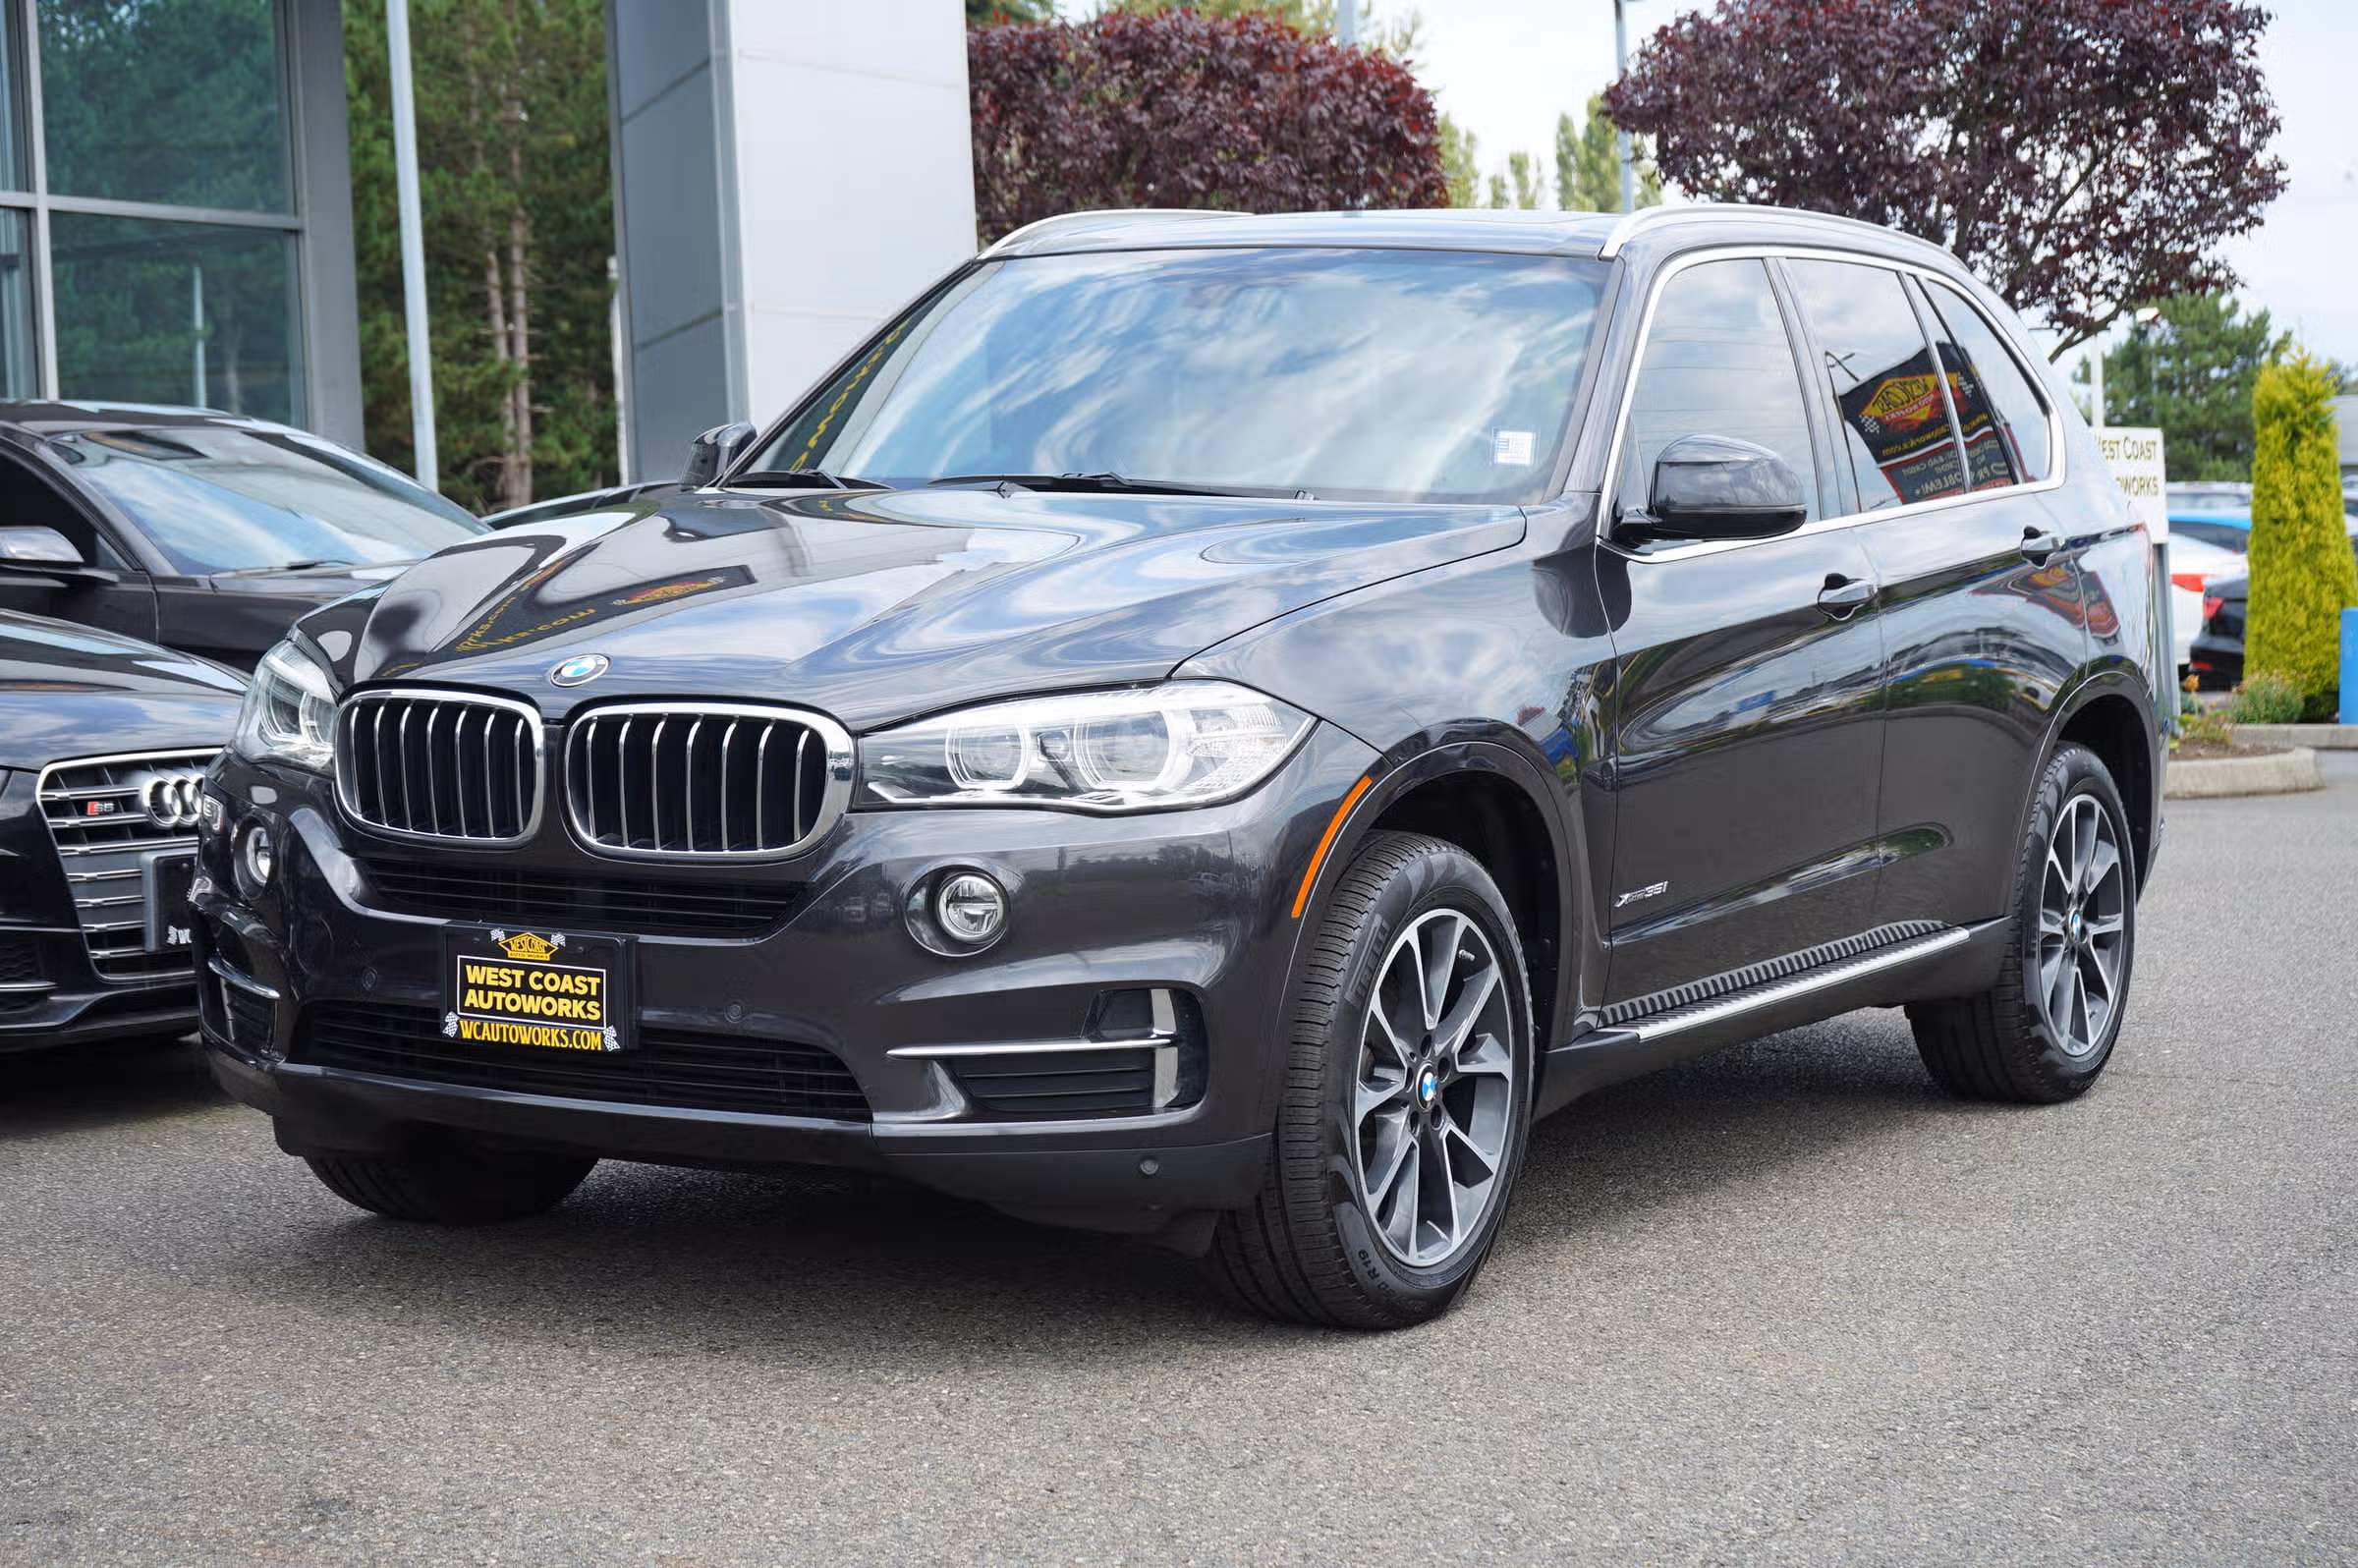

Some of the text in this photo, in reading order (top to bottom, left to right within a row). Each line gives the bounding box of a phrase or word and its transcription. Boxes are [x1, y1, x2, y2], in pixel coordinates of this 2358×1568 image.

[2095, 436, 2158, 460] EST COAST
[2116, 476, 2160, 496] WORKS
[510, 936, 547, 953] WEST COAST
[466, 965, 600, 996] WEST COAST
[465, 989, 601, 1021] AUTOWORKS
[460, 1020, 602, 1050] WCAUTOWORKS.COM
